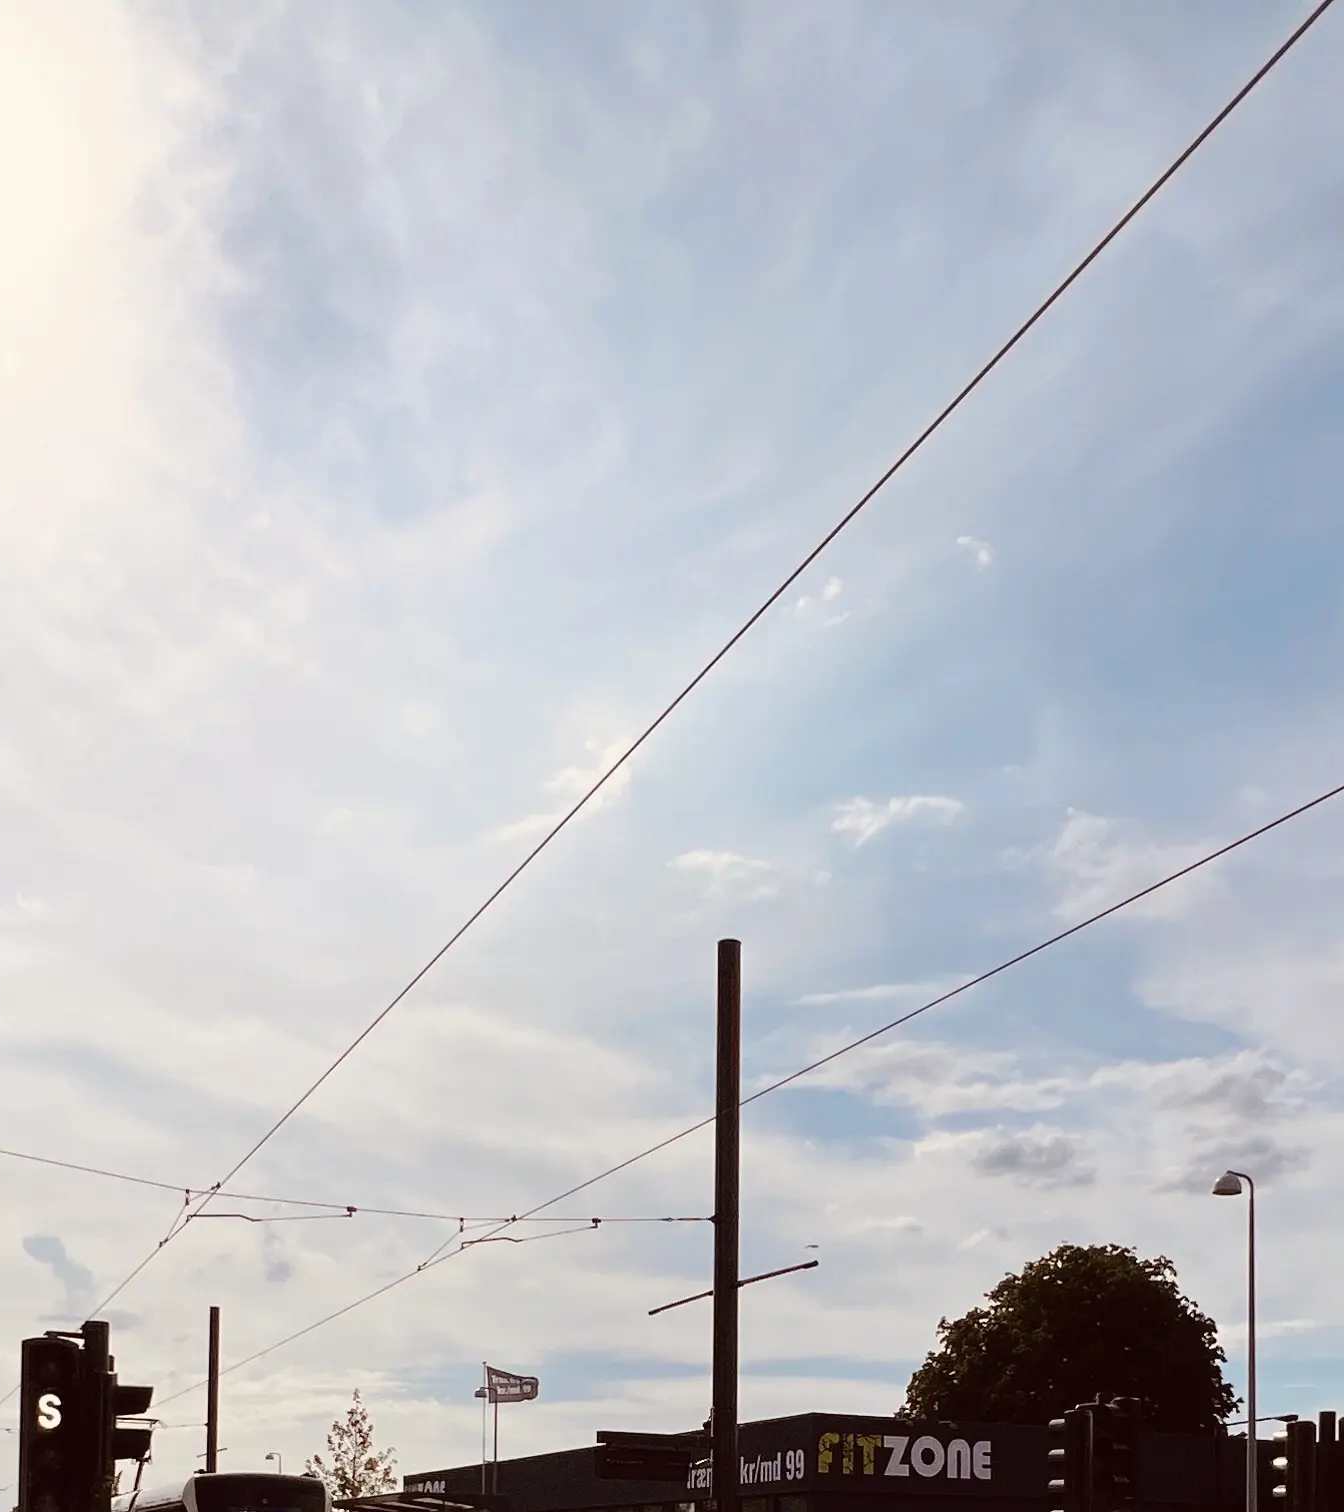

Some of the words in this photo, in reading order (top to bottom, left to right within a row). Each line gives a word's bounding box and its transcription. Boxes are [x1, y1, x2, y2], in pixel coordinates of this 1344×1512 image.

[38, 1393, 62, 1429] S
[739, 1452, 781, 1485] kr/md
[785, 1449, 805, 1480] 99
[817, 1432, 992, 1481] FITZONE
